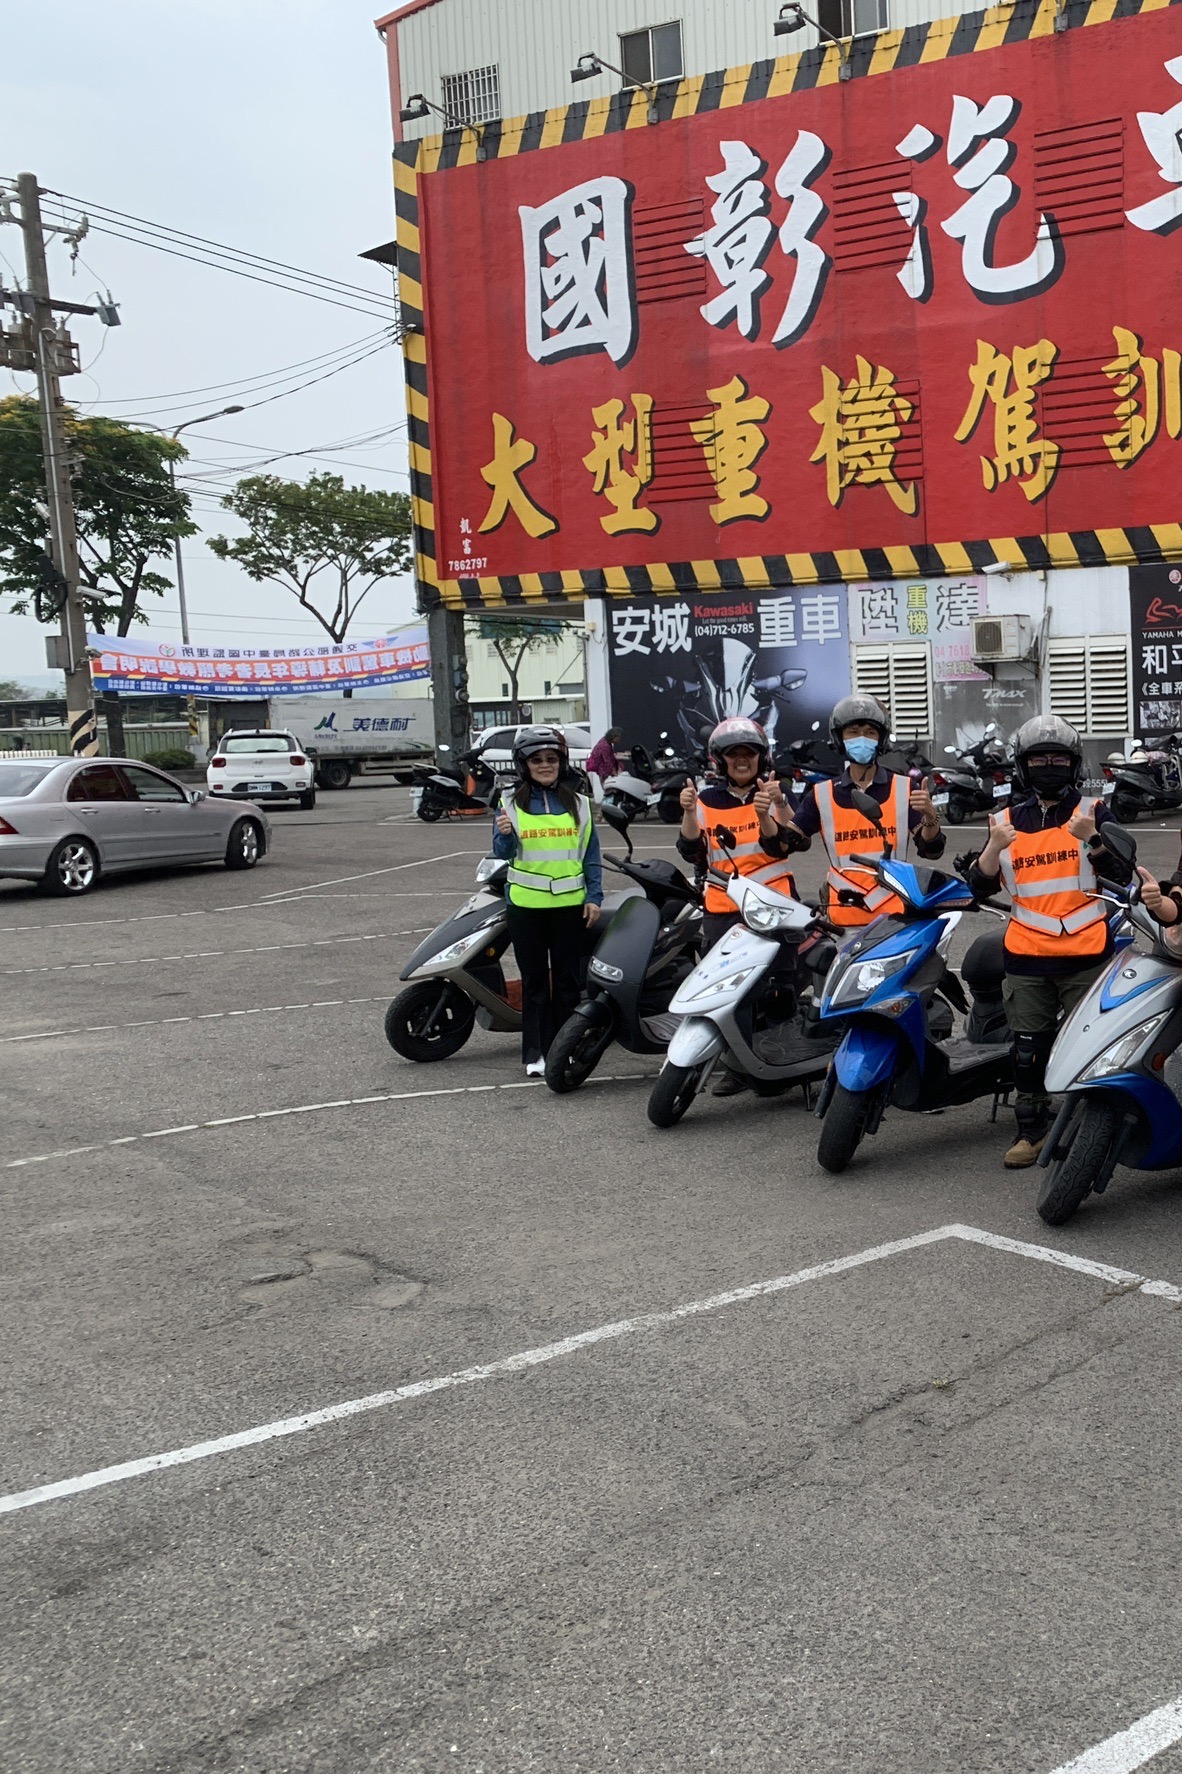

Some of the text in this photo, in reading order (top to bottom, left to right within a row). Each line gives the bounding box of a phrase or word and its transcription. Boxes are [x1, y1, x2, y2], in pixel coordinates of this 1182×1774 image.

[448, 557, 488, 571] 7862797
[694, 603, 753, 618] Kawasaki
[907, 584, 928, 634] 重機
[612, 594, 842, 656] 安城 重車
[694, 623, 755, 637] (04)712-6785
[1142, 631, 1174, 639] YAMAHA
[343, 718, 416, 732] 美德耐
